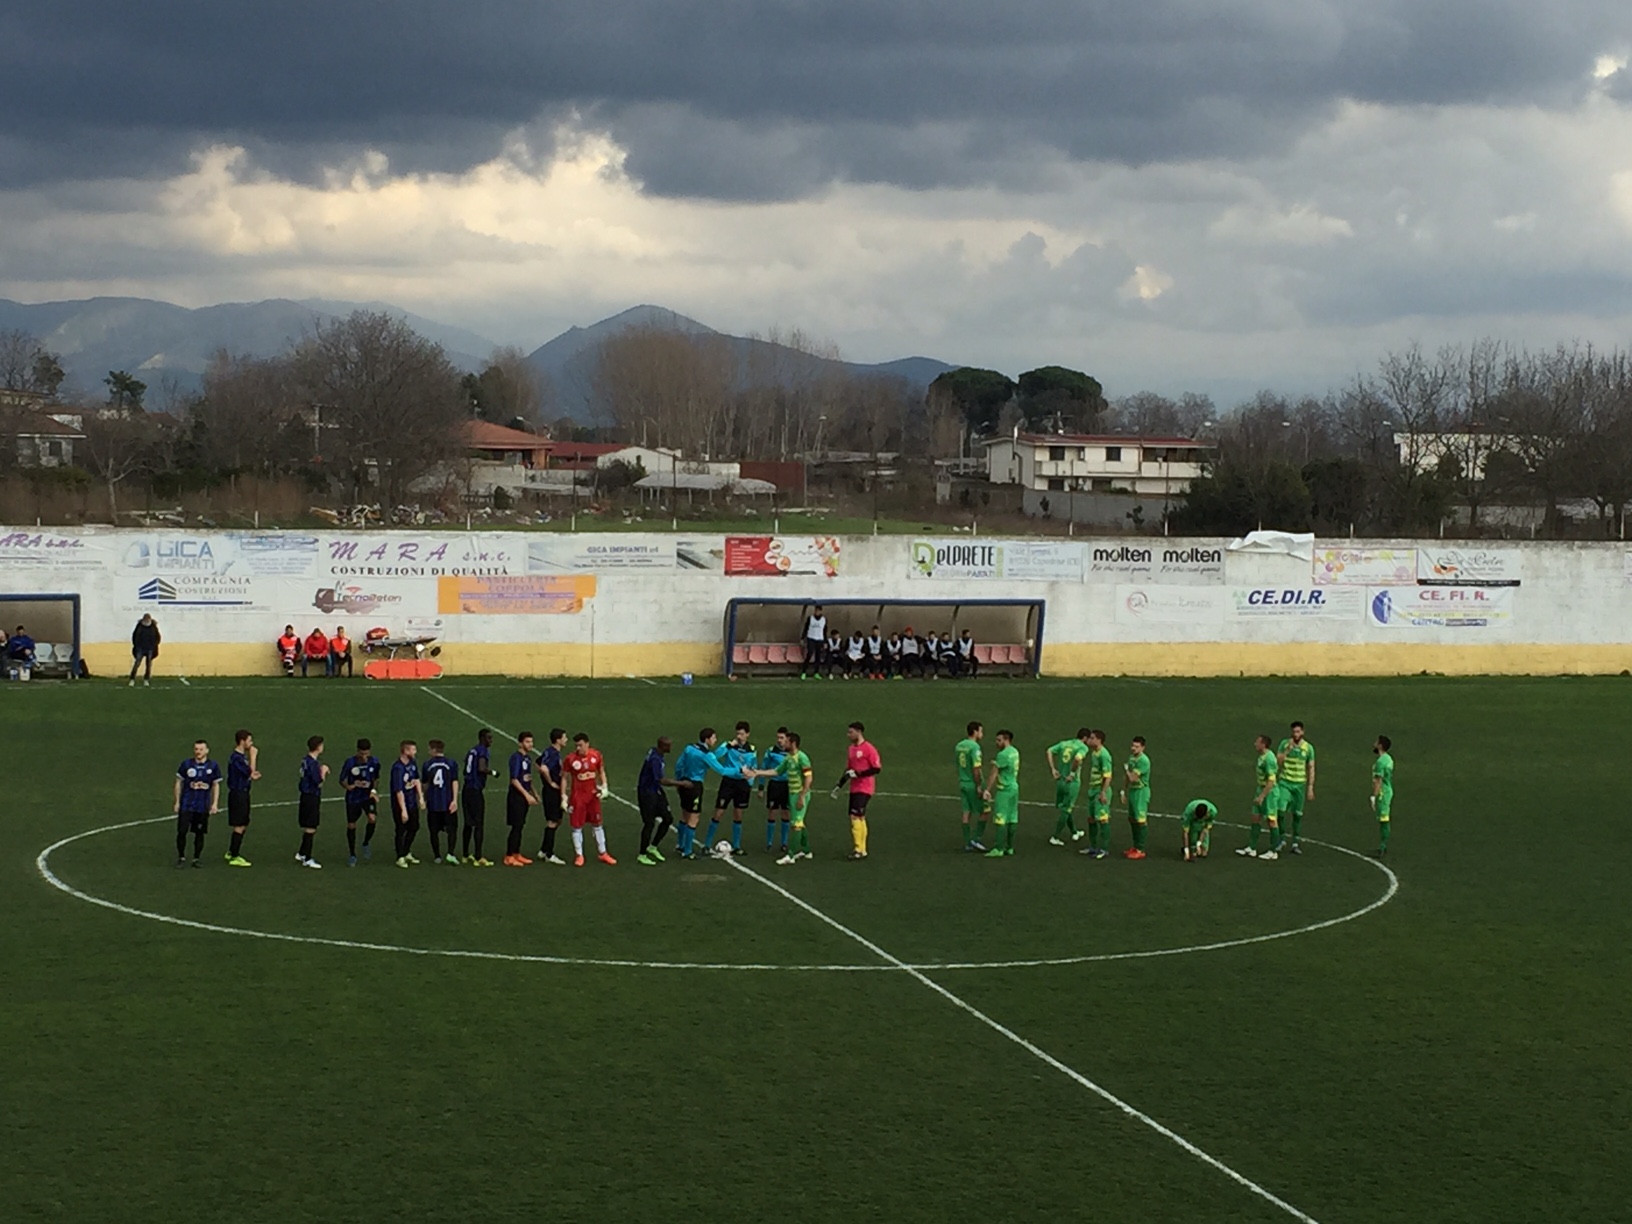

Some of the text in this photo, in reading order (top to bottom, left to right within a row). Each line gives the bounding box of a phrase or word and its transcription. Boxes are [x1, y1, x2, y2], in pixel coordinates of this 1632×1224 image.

[1093, 547, 1152, 562] molten
[1163, 548, 1221, 562] molten
[331, 564, 509, 577] COSTRUZIONI DI QUALITÀ
[174, 576, 251, 586] COMPAGNIA
[178, 587, 248, 596] COSTRUZIONI
[1248, 590, 1327, 605] CE.DI.R.
[1419, 590, 1446, 601] CE.
[1450, 590, 1470, 601] FI.
[433, 768, 445, 788] 4
